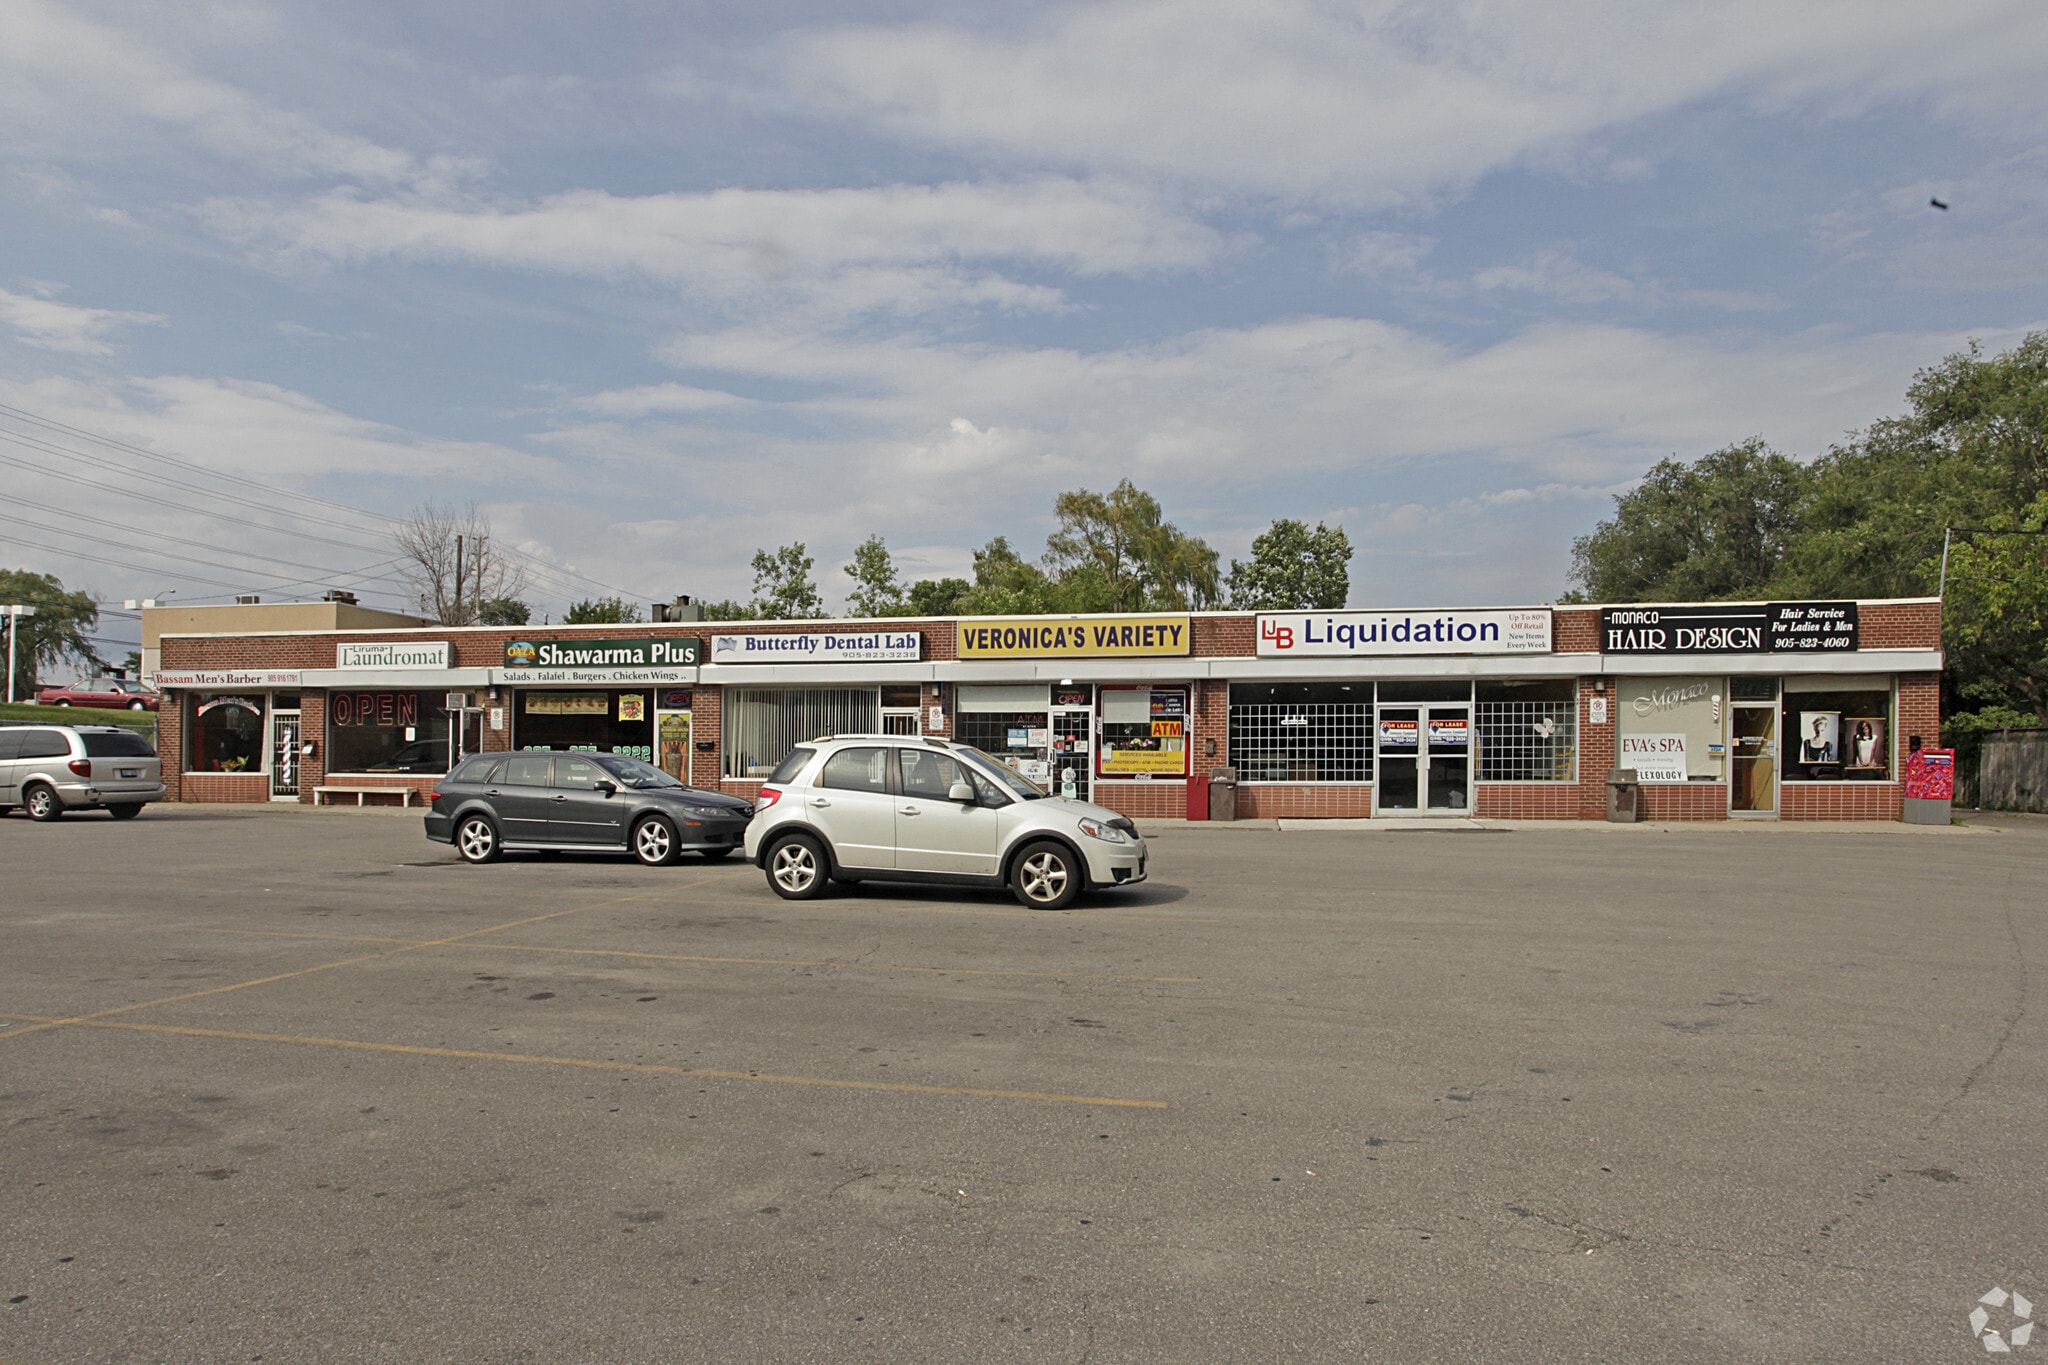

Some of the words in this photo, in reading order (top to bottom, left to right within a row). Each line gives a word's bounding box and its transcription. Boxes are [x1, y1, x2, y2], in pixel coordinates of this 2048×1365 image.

[1611, 611, 1659, 624] MONACO
[1780, 608, 1804, 619] Hair
[1807, 607, 1845, 619] Service
[1305, 617, 1499, 649] Liquidation
[1771, 622, 1787, 632] For
[1790, 621, 1820, 632] Ladies
[1822, 621, 1831, 631] &
[1834, 621, 1853, 631] Men
[745, 635, 819, 653] Butterfly
[824, 634, 879, 649] Dental
[885, 633, 916, 649] Lab
[963, 626, 1086, 649] VERONICA'S
[1093, 625, 1183, 647] VARIETY
[1607, 628, 1667, 650] HAIR
[1675, 627, 1762, 649] DESIGN
[1775, 637, 1850, 648] 905-823-4060
[342, 646, 444, 666] Laundromat
[507, 647, 536, 657] OAZA
[538, 643, 645, 665] Shawarma
[651, 641, 695, 663] Plus
[155, 674, 193, 684] Bassam
[195, 674, 225, 684] Men's
[226, 674, 262, 684] Barber
[504, 672, 531, 681] Salads
[538, 672, 565, 681] Falafel
[573, 671, 606, 683] Burgers
[613, 671, 649, 680] Chicken
[651, 671, 679, 681] Wings
[1058, 694, 1085, 704] OPEN
[333, 694, 417, 726] OPEN
[1153, 723, 1181, 735] ATM
[1623, 739, 1656, 752] EVA's
[1659, 738, 1684, 752] SPA
